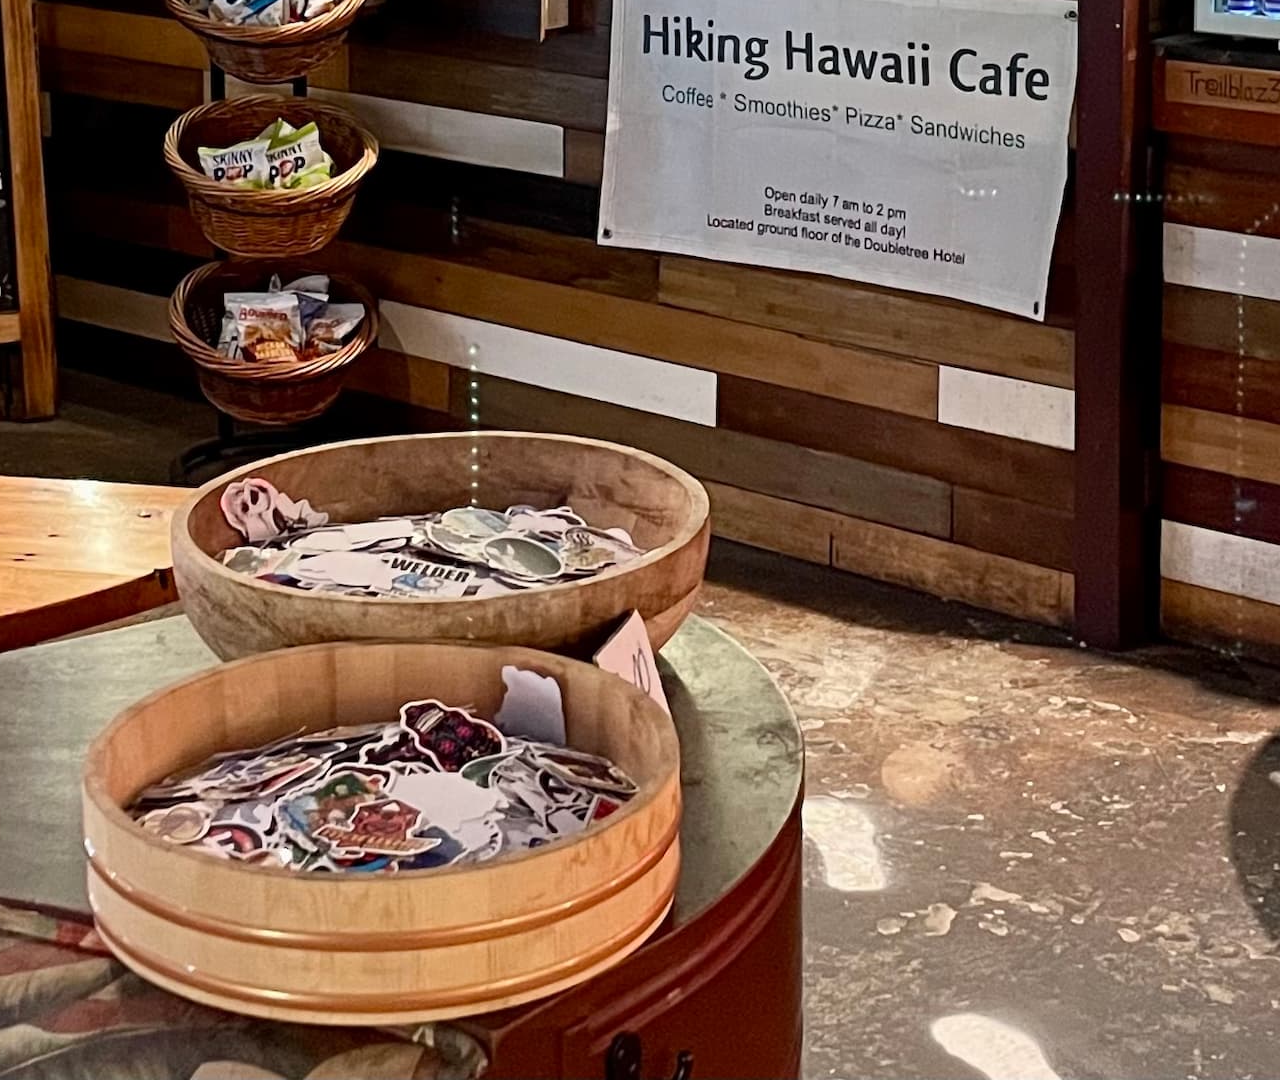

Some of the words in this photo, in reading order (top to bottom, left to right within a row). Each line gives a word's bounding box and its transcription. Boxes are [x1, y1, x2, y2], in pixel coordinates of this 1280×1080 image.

[643, 14, 769, 80] Hiking
[786, 30, 930, 86] Hawaii
[949, 48, 1050, 100] Cafe
[661, 84, 713, 108] Coffee
[911, 115, 1025, 149] Sandwiches
[213, 148, 253, 166] SKINNY
[764, 186, 796, 203] Open
[800, 192, 828, 209] daily
[832, 195, 838, 208] 7
[842, 199, 859, 211] am
[862, 202, 873, 214] to
[876, 204, 884, 216] 2
[887, 206, 906, 220] pm
[764, 204, 820, 224] Breakfast
[824, 214, 861, 230] served
[864, 220, 878, 233] all
[707, 214, 754, 231] Located
[757, 221, 797, 237] ground
[801, 226, 828, 242] floor
[831, 231, 841, 243] of
[845, 234, 861, 248] the
[864, 237, 929, 260] Doubletree
[933, 247, 965, 265] Hotel
